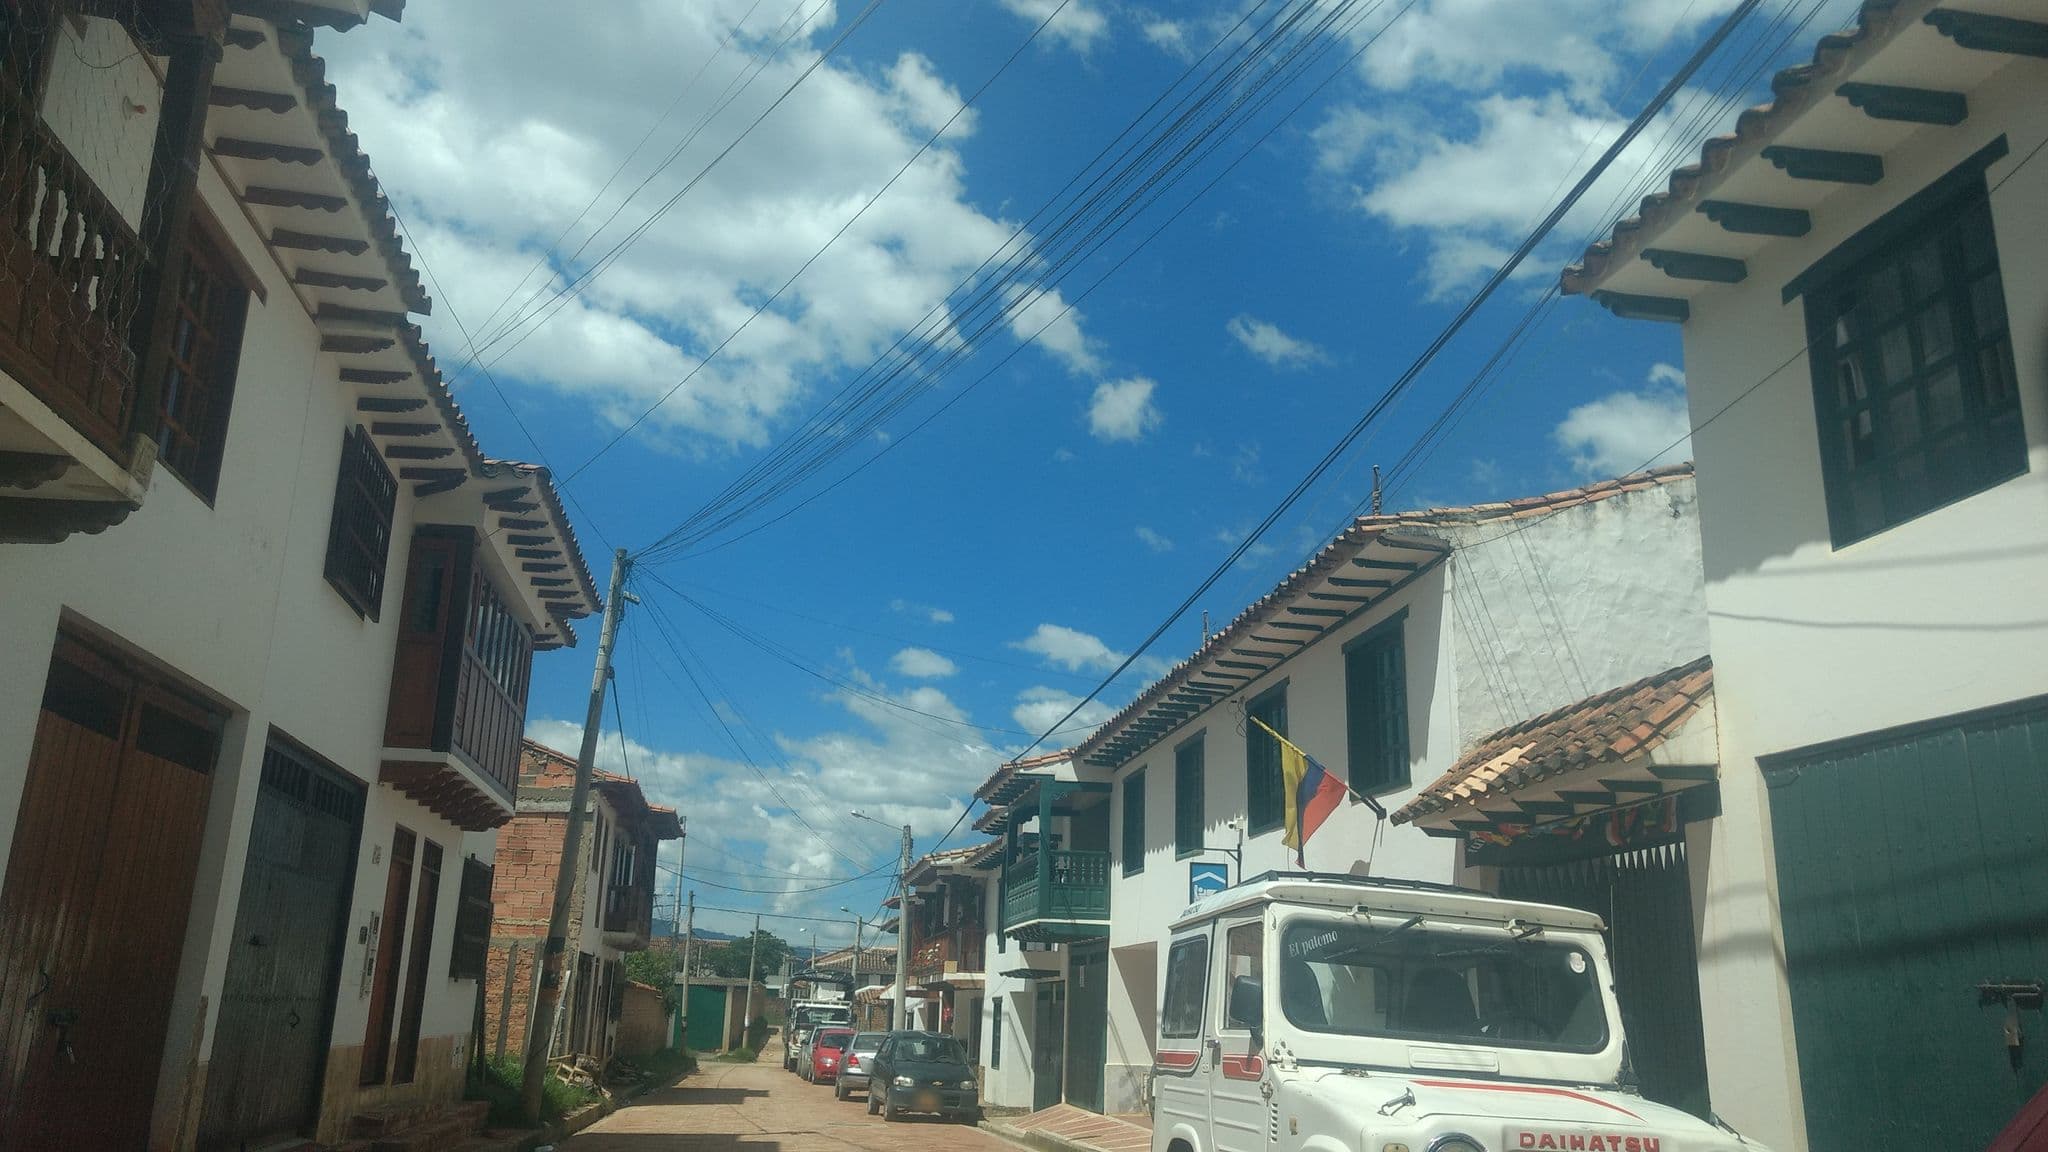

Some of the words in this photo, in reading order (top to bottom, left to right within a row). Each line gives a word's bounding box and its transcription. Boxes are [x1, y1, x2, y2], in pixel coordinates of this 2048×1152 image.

[1288, 942, 1300, 957] El
[1302, 930, 1338, 956] palomo
[1519, 1132, 1660, 1152] DAIHATSU
